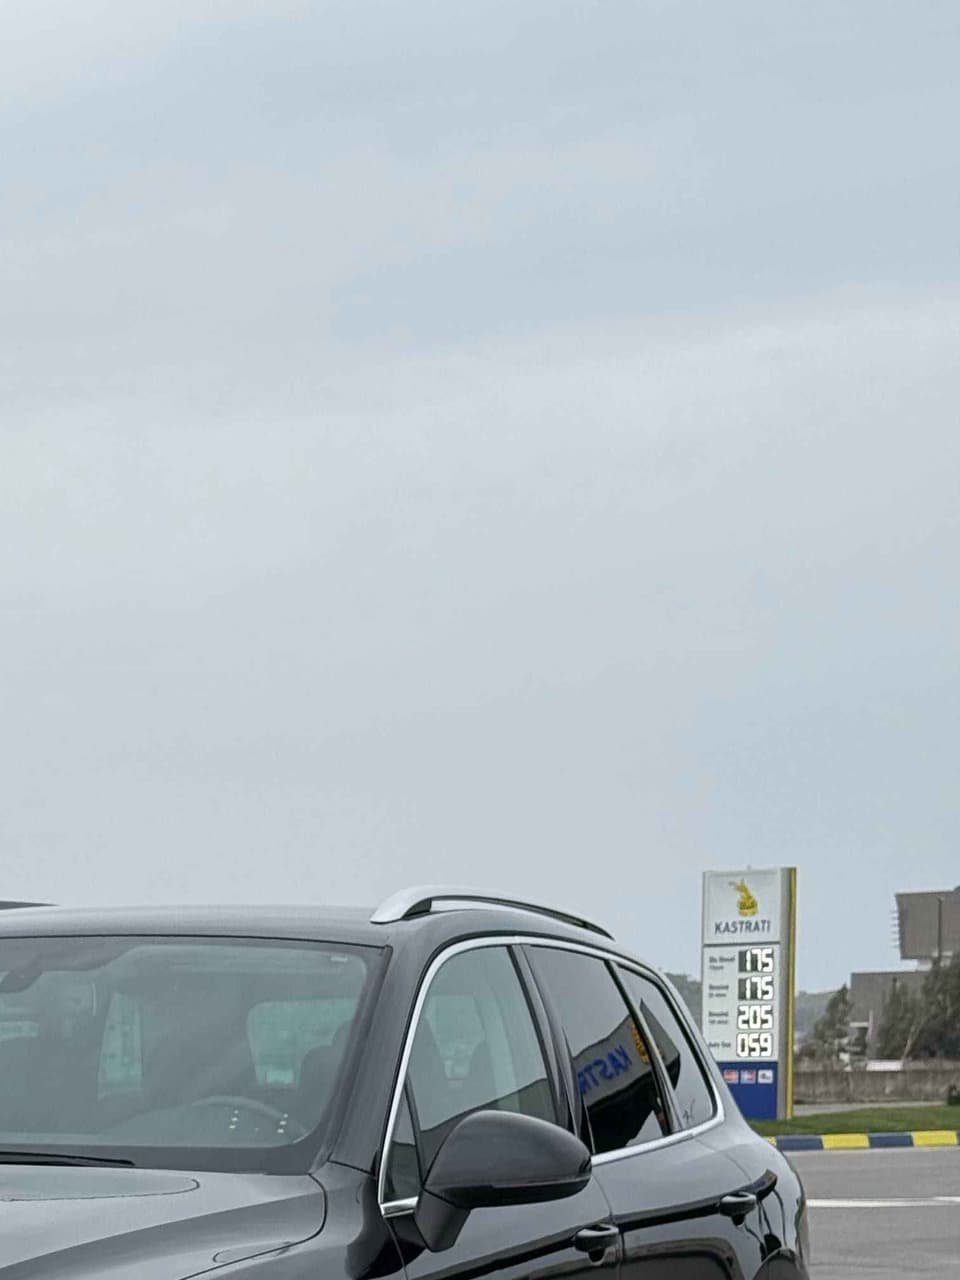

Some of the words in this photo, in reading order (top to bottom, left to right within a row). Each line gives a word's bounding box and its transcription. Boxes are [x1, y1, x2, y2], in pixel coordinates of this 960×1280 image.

[714, 919, 771, 935] KASTRATI
[746, 948, 774, 973] 175
[746, 976, 773, 1000] 175
[738, 1004, 773, 1029] 205
[737, 1032, 772, 1057] 059
